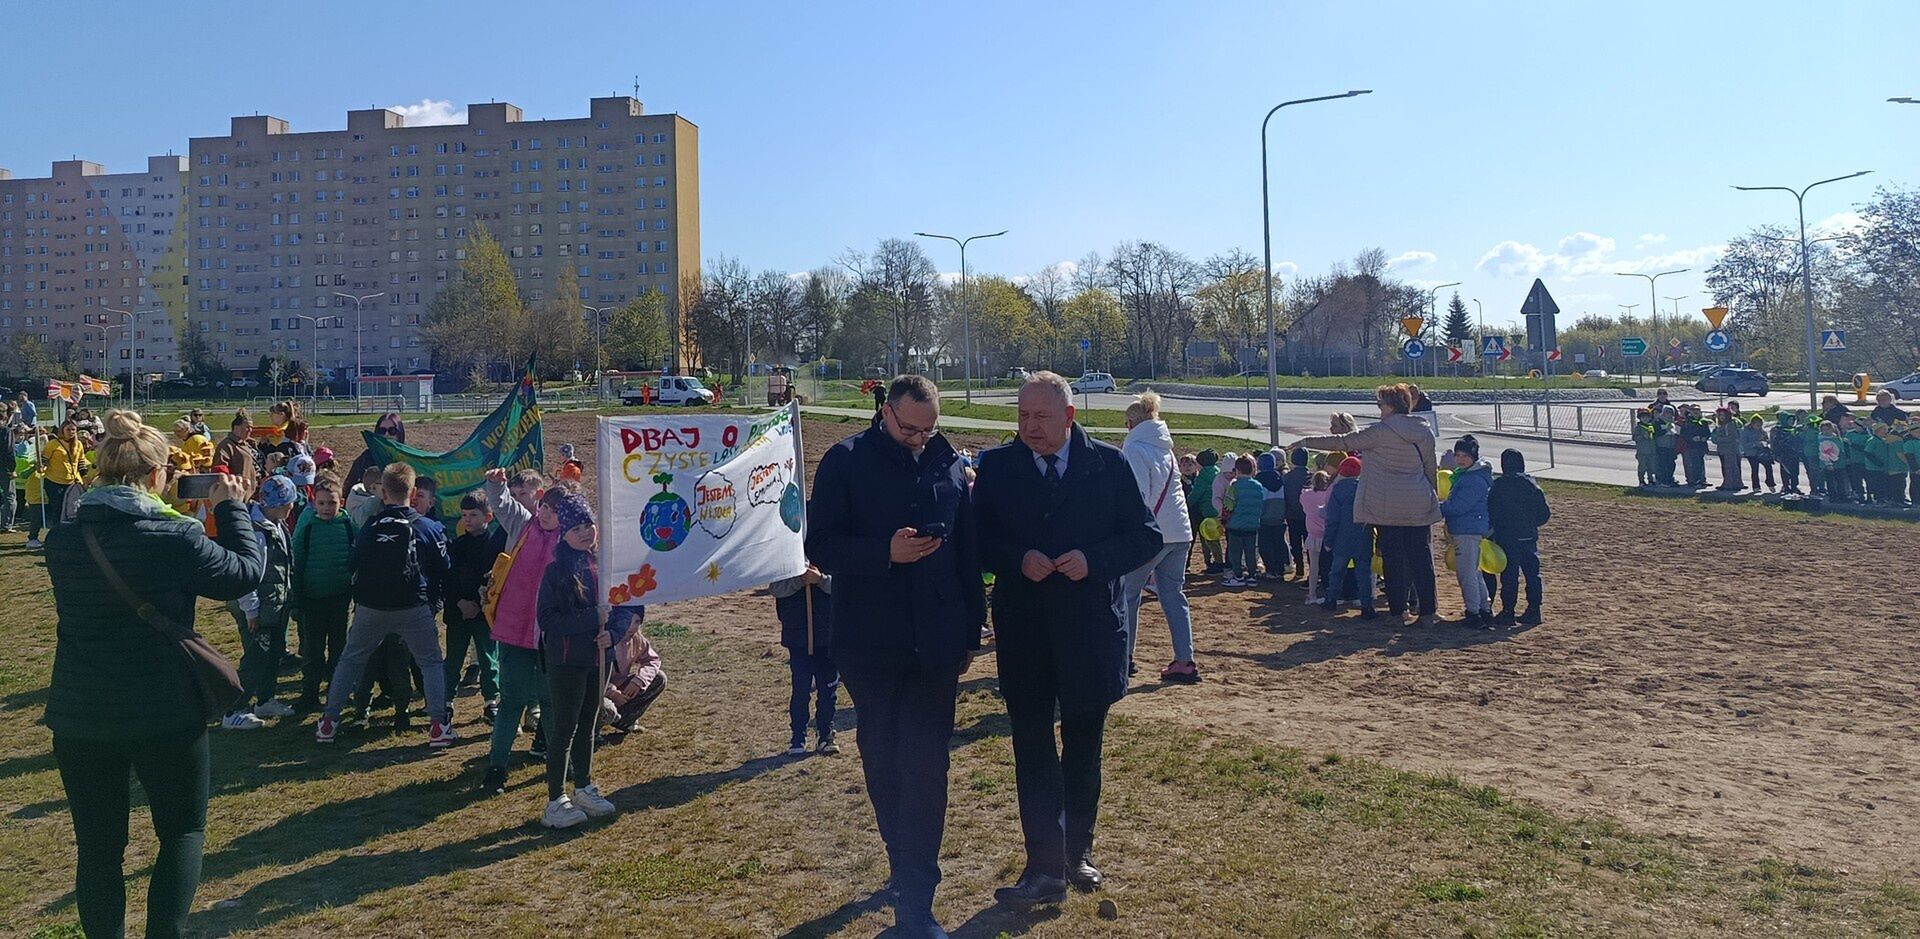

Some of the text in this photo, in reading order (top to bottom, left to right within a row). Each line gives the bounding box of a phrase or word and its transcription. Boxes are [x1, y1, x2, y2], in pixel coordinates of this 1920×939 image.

[620, 426, 700, 454] DBAJ
[722, 425, 739, 447] O
[623, 452, 708, 484] CZYSTE
[713, 444, 740, 464] LASY
[751, 465, 777, 491] JESTEM
[697, 484, 733, 506] JESTEM
